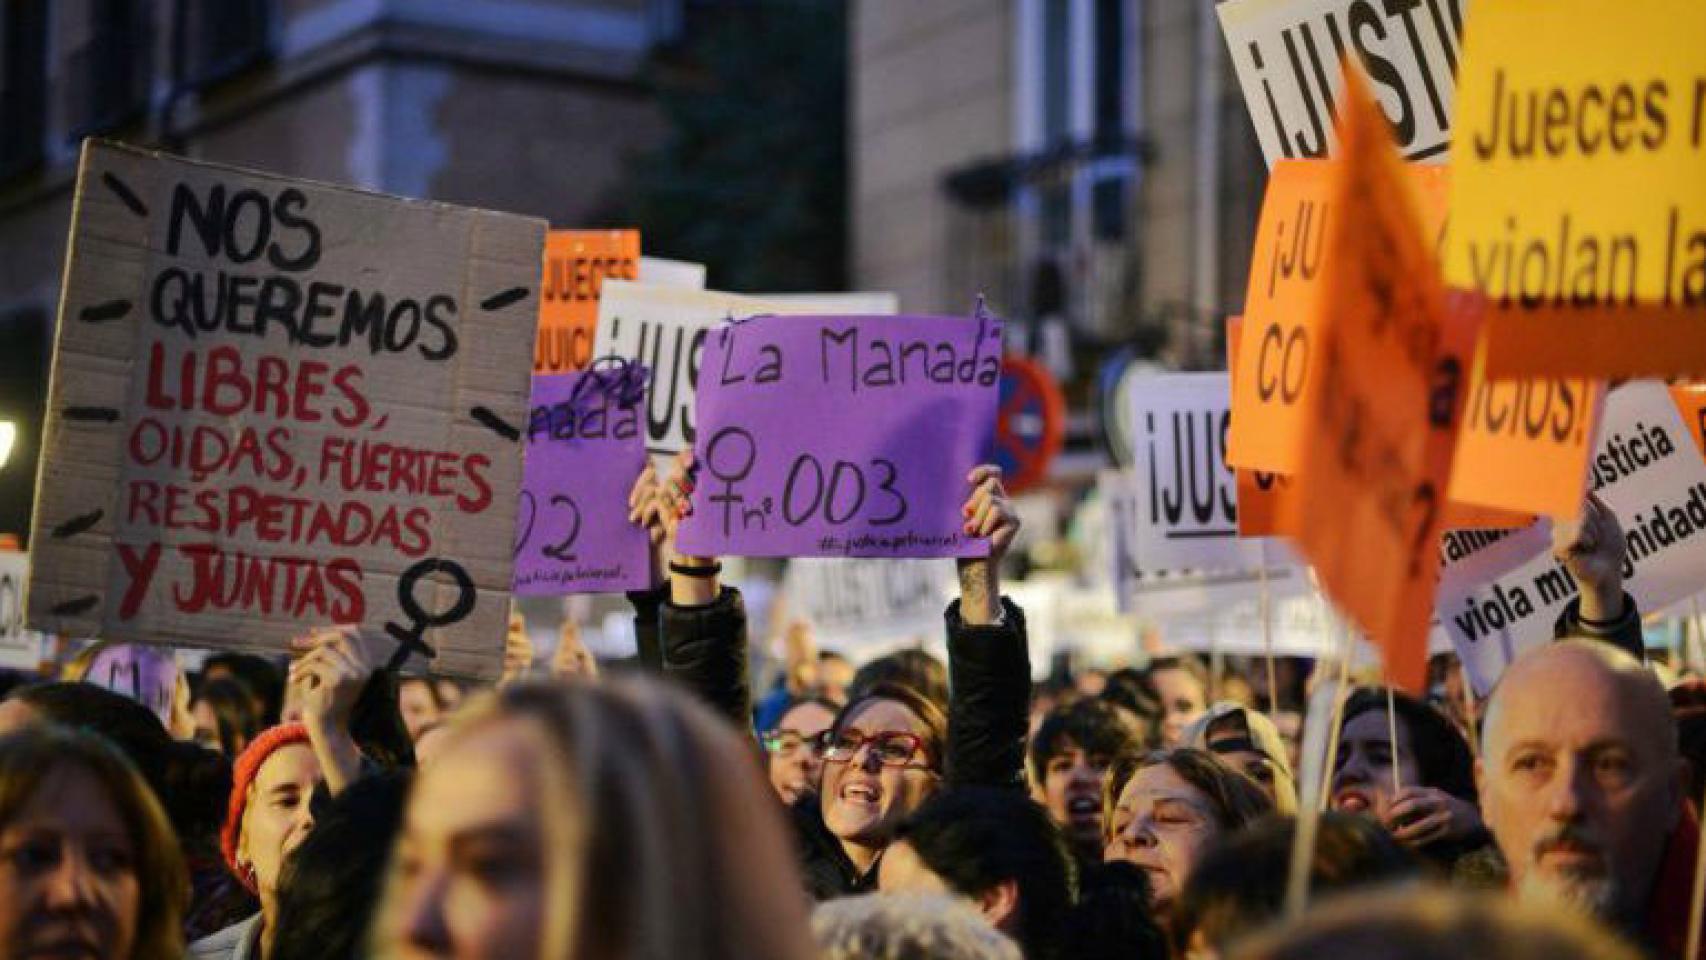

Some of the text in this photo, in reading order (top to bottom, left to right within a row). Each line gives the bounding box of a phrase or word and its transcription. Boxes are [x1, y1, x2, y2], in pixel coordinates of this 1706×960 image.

[1473, 70, 1669, 160] Jueces
[167, 183, 322, 271] NOS
[1469, 213, 1640, 309] violan
[150, 268, 458, 361] QUEREMOS
[146, 341, 390, 431] LIBRES,
[319, 437, 493, 513] FUERTES
[783, 454, 906, 526] 003
[127, 481, 431, 557] RESPETADAS
[115, 542, 161, 621] Y
[172, 542, 364, 625] JUNTAS
[1455, 584, 1534, 642] viola
[1533, 566, 1578, 606] mi
